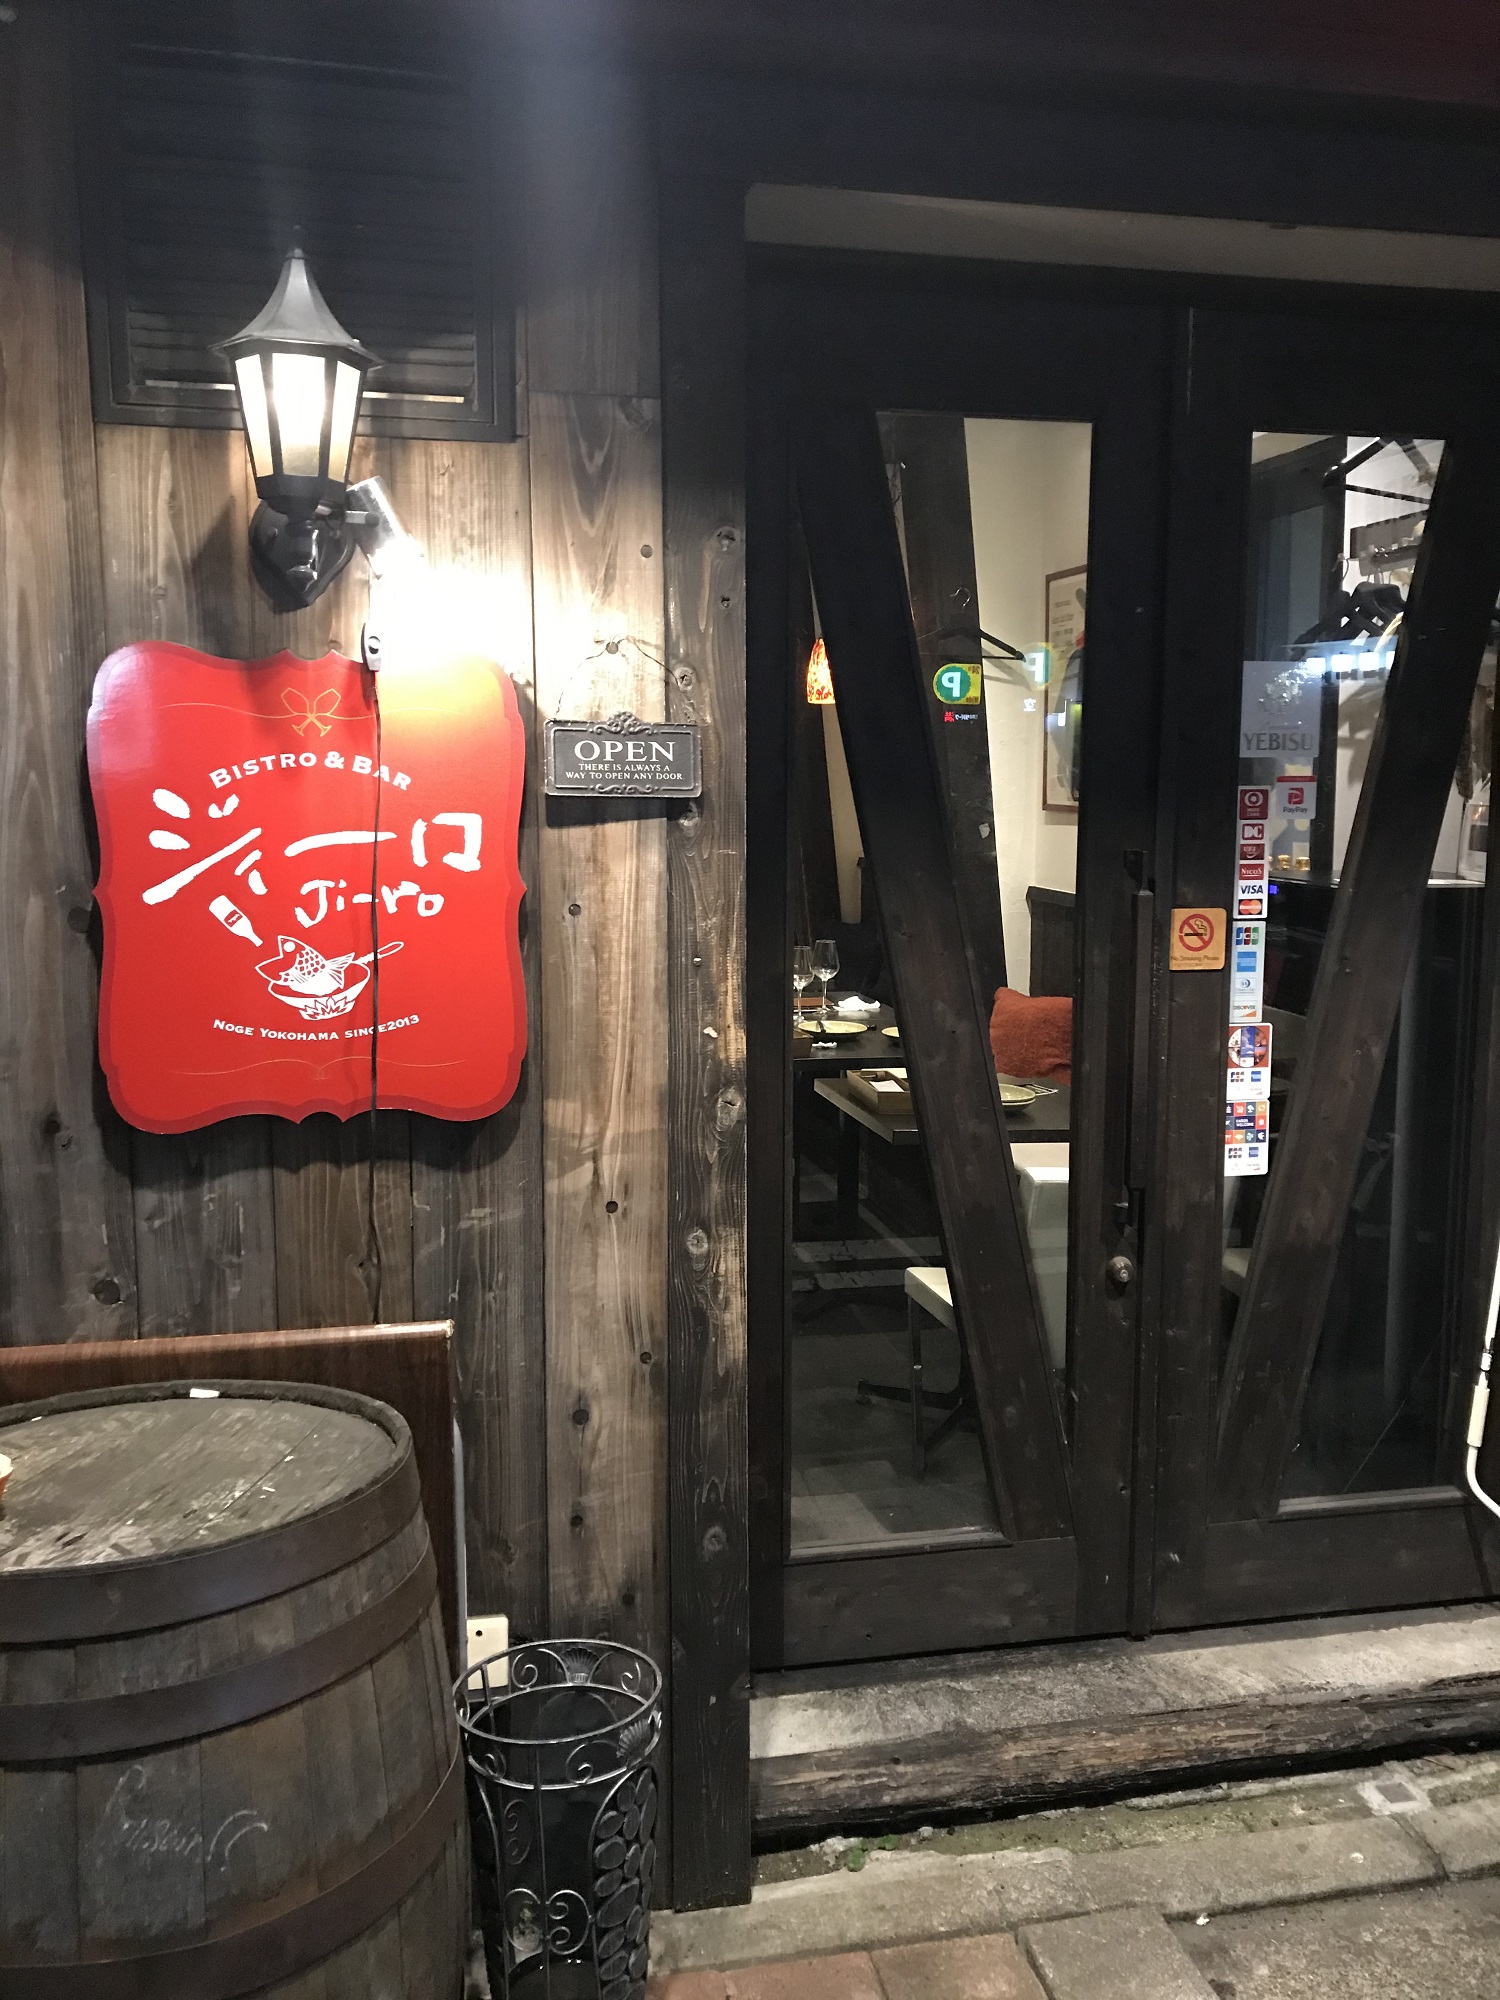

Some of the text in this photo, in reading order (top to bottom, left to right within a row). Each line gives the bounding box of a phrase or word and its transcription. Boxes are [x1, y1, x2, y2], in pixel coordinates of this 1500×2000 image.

[1243, 732, 1314, 751] YEBISU
[574, 740, 676, 762] OPEN
[208, 751, 318, 790] BISTRO
[323, 750, 346, 770] &
[578, 763, 610, 771] THERE
[612, 763, 622, 771] IS
[624, 764, 661, 772] ALWAYS
[565, 771, 587, 780] WAY
[588, 772, 602, 780] TO
[604, 772, 631, 780] OPEN
[632, 772, 654, 780] ANY
[1282, 806, 1309, 815] PayPay
[1244, 825, 1263, 838] DC
[1241, 884, 1263, 895] VISA
[213, 1018, 254, 1037] NOGE
[258, 1027, 340, 1042] YOKOHAMA
